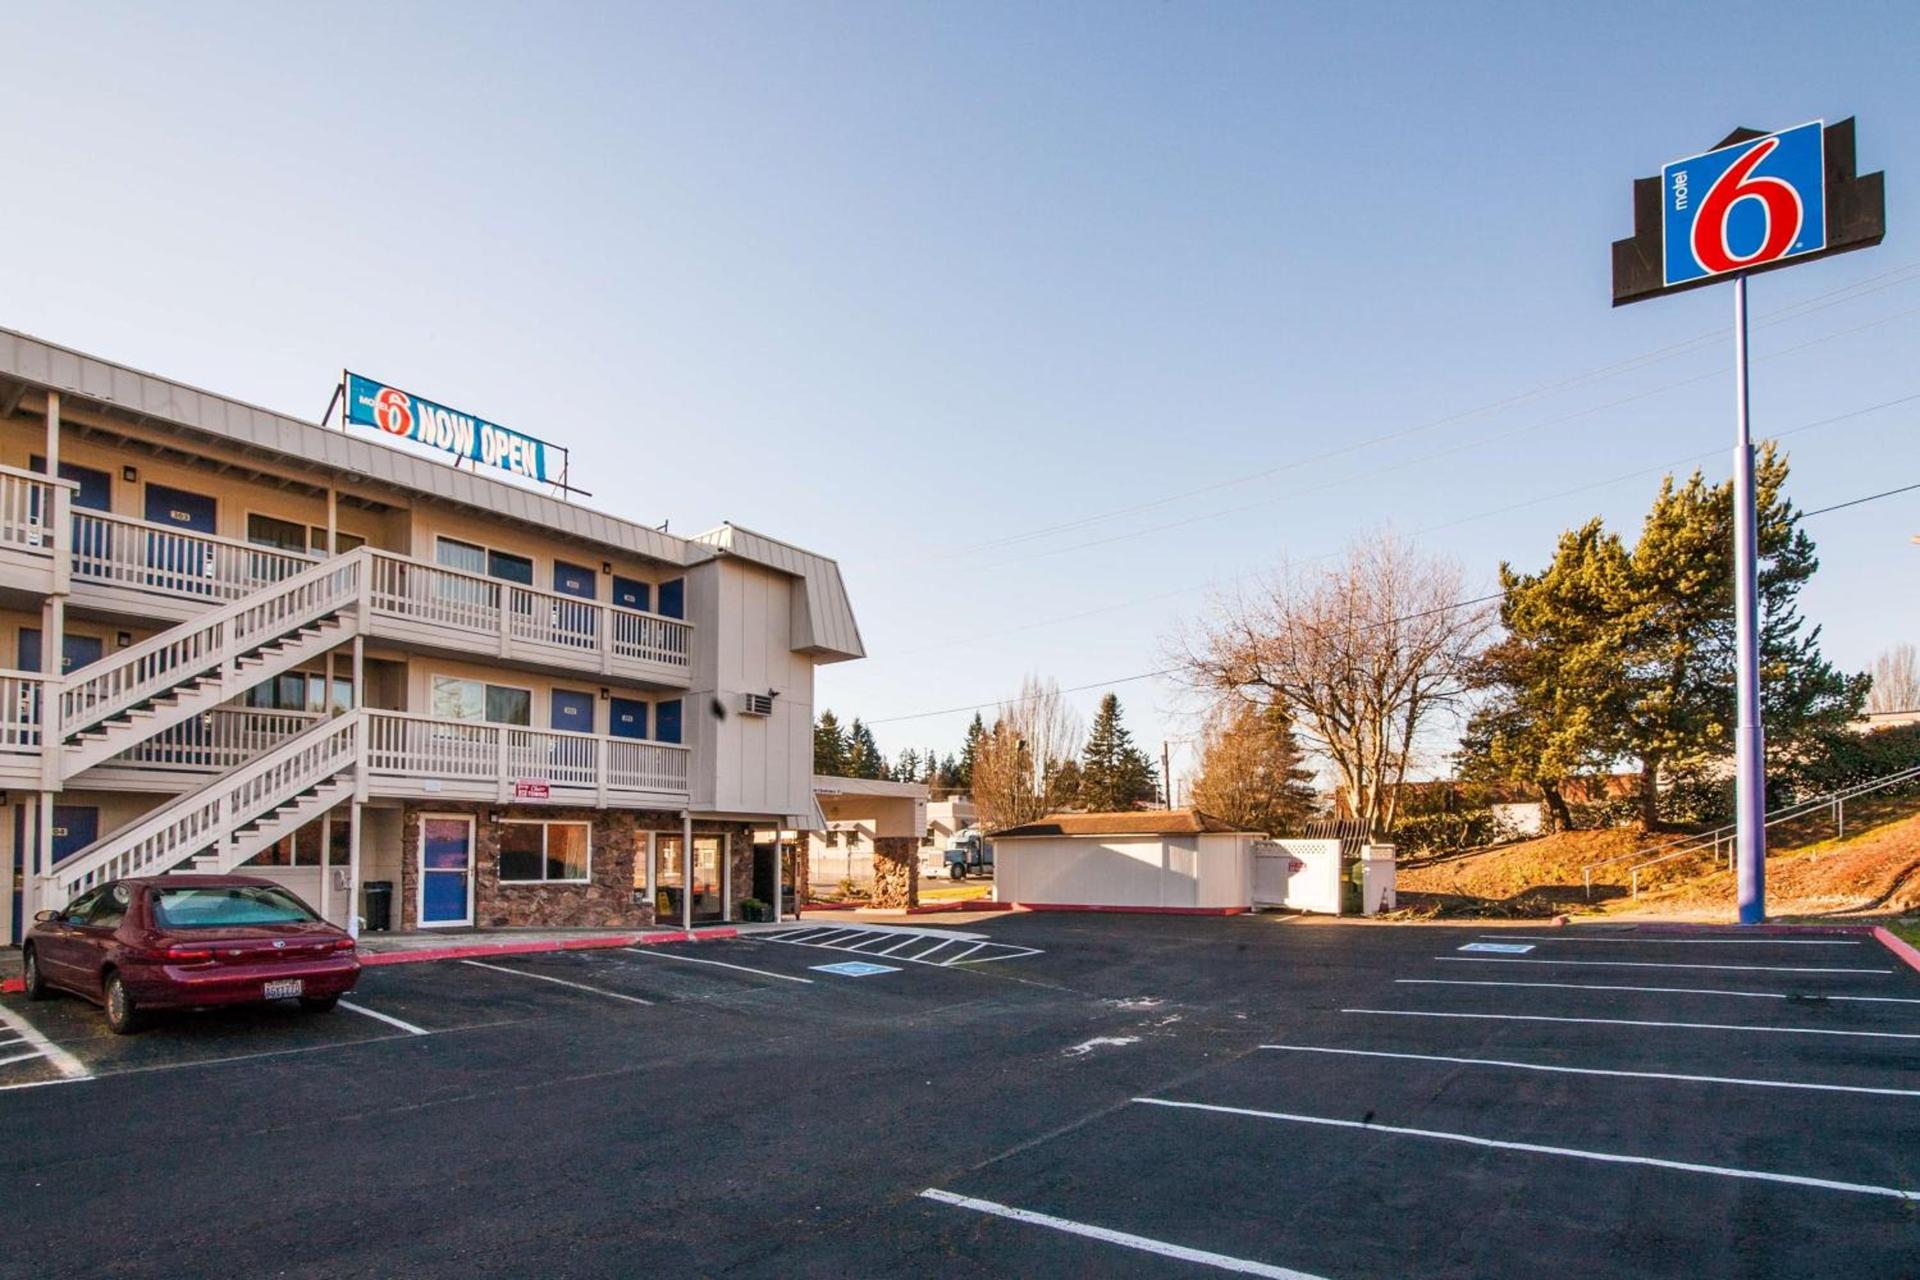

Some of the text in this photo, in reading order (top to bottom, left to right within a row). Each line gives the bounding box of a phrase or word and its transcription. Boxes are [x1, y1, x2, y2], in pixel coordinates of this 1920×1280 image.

[1672, 170, 1688, 210] motel
[1690, 136, 1804, 275] 6
[374, 386, 415, 437] 6
[416, 402, 475, 457] NOW
[481, 424, 538, 480] OPEN
